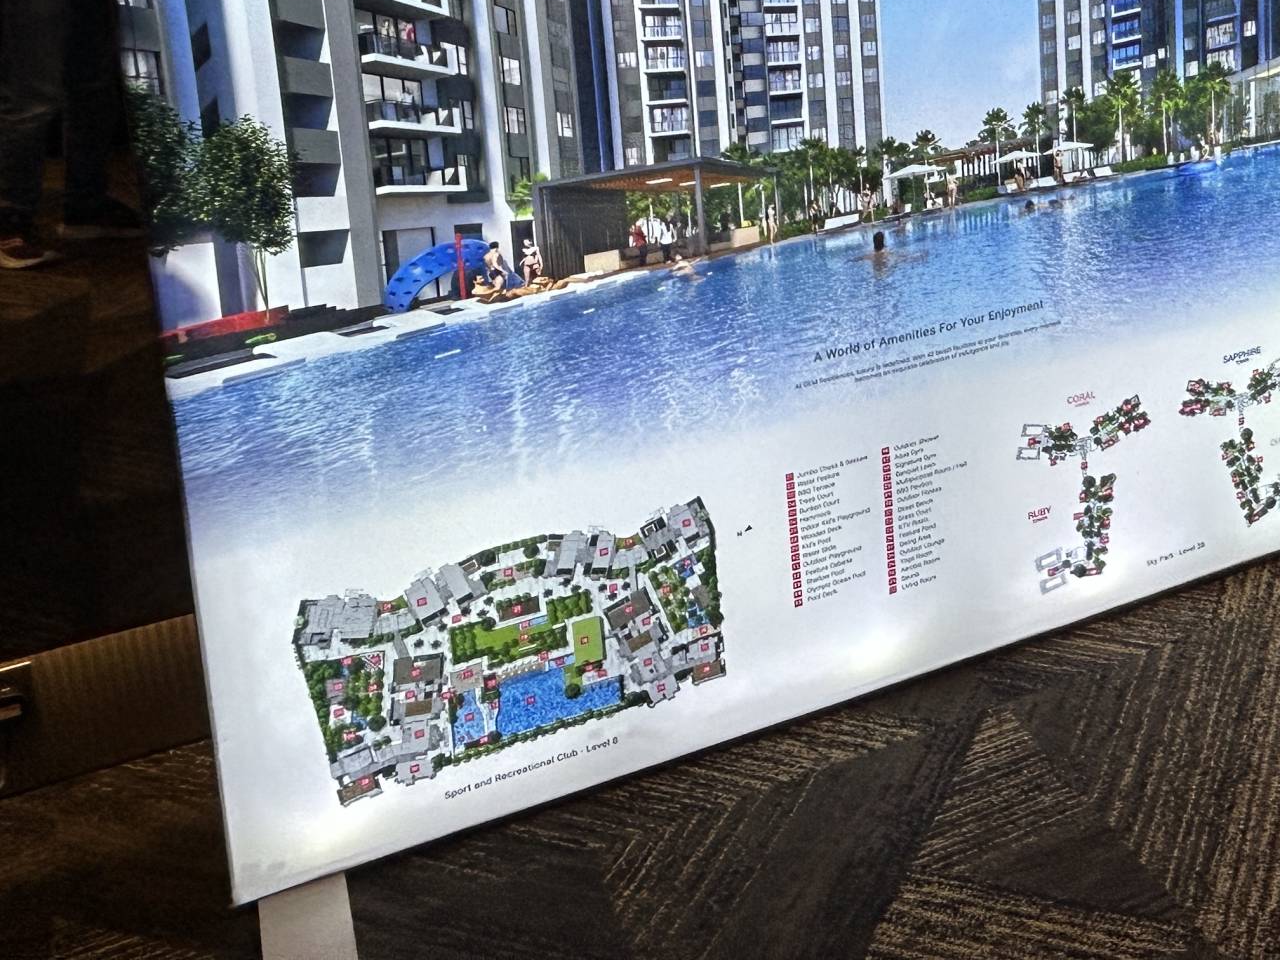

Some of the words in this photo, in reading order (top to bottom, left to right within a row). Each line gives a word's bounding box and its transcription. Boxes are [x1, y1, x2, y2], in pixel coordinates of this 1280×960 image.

[813, 352, 823, 362] A
[825, 343, 861, 360] World
[863, 340, 876, 351] of
[878, 326, 936, 349] Amenities
[939, 321, 958, 334] For
[960, 315, 985, 328] Your
[988, 300, 1044, 321] Enjoyment
[1067, 391, 1096, 404] CORAL
[1027, 505, 1051, 520] RUBY
[444, 784, 472, 799] Sport
[474, 776, 493, 790] and
[495, 756, 555, 782] Recreational
[557, 749, 578, 762] Club
[586, 740, 610, 752] Level
